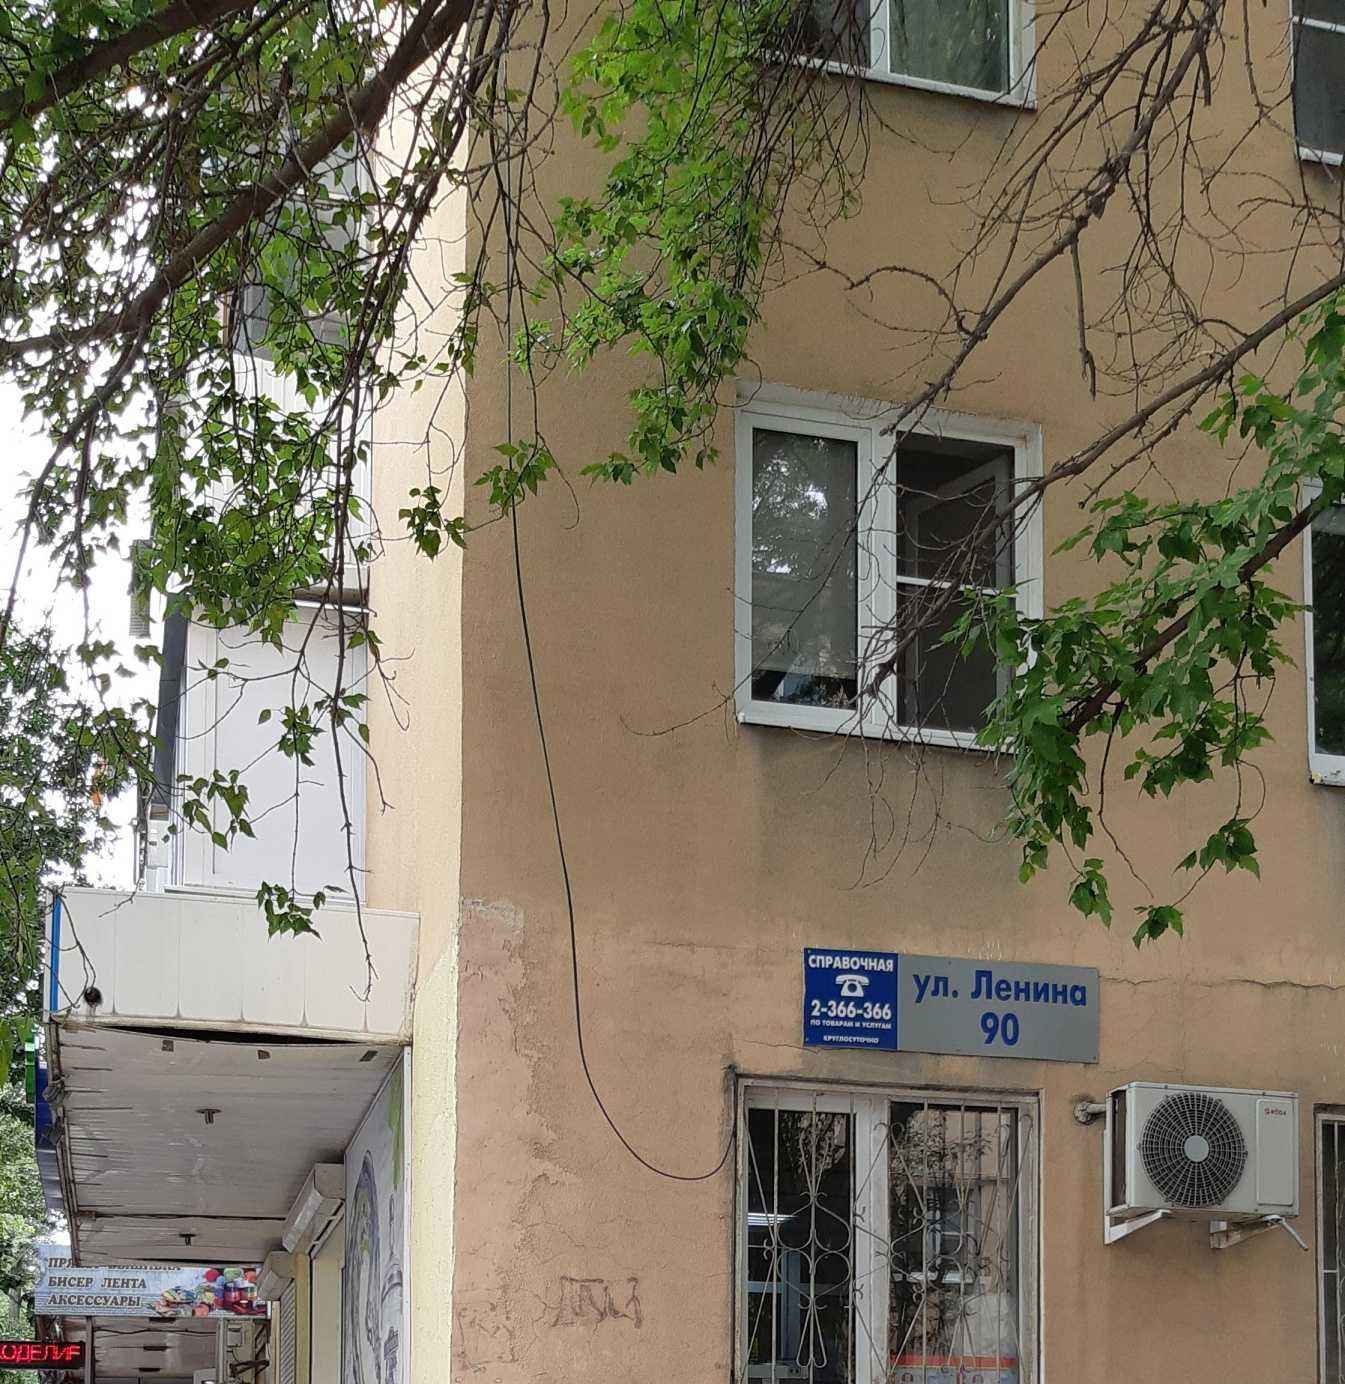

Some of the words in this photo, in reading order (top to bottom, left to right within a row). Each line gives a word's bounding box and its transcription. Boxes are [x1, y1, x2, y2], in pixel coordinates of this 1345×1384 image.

[808, 953, 894, 972] СПРАВОЧНАЯ
[912, 973, 959, 1004] ул.
[970, 969, 1088, 1006] Ленина
[810, 999, 892, 1021] 2-366-366
[822, 1020, 854, 1028] ТОВАРАМ
[862, 1022, 892, 1030] УСЛУГАМ
[980, 1011, 1020, 1046] 90
[823, 1035, 880, 1044] КРУГЛОСУТОЧНО
[47, 1276, 94, 1288] БИСЕР
[100, 1277, 148, 1289] ЛЕНТА
[47, 1294, 142, 1307] АКСЕССУАРЫ
